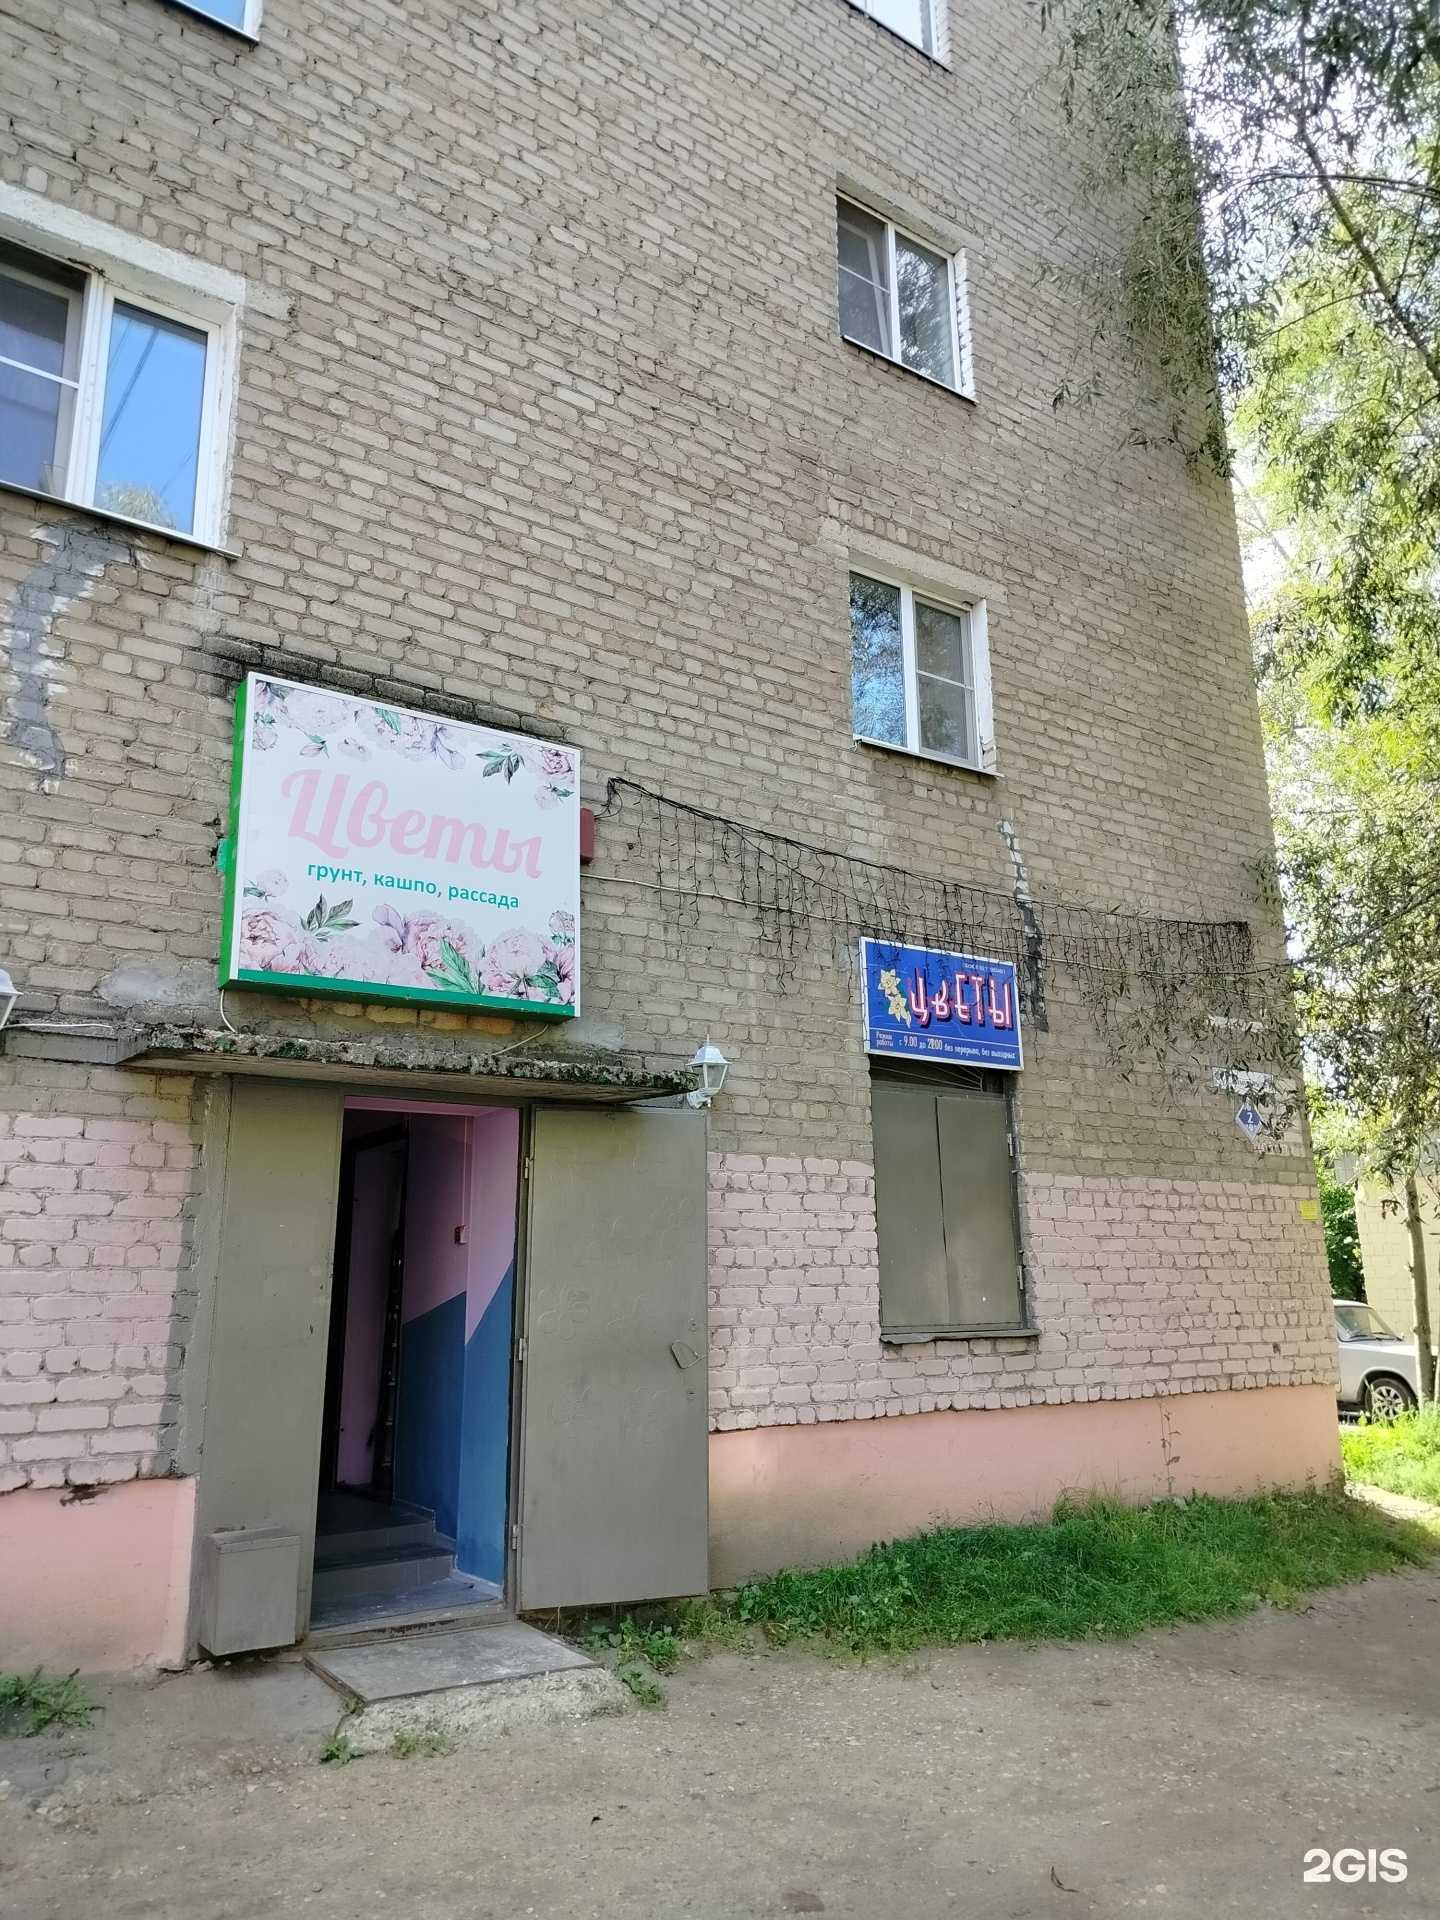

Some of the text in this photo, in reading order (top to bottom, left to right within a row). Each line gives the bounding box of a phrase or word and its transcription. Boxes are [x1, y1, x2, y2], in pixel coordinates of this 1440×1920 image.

[281, 769, 543, 879] Цветы
[307, 863, 519, 910] грунт, кашпо, рассада
[903, 1035, 918, 1047] 9.00
[1247, 1112, 1254, 1124] 2
